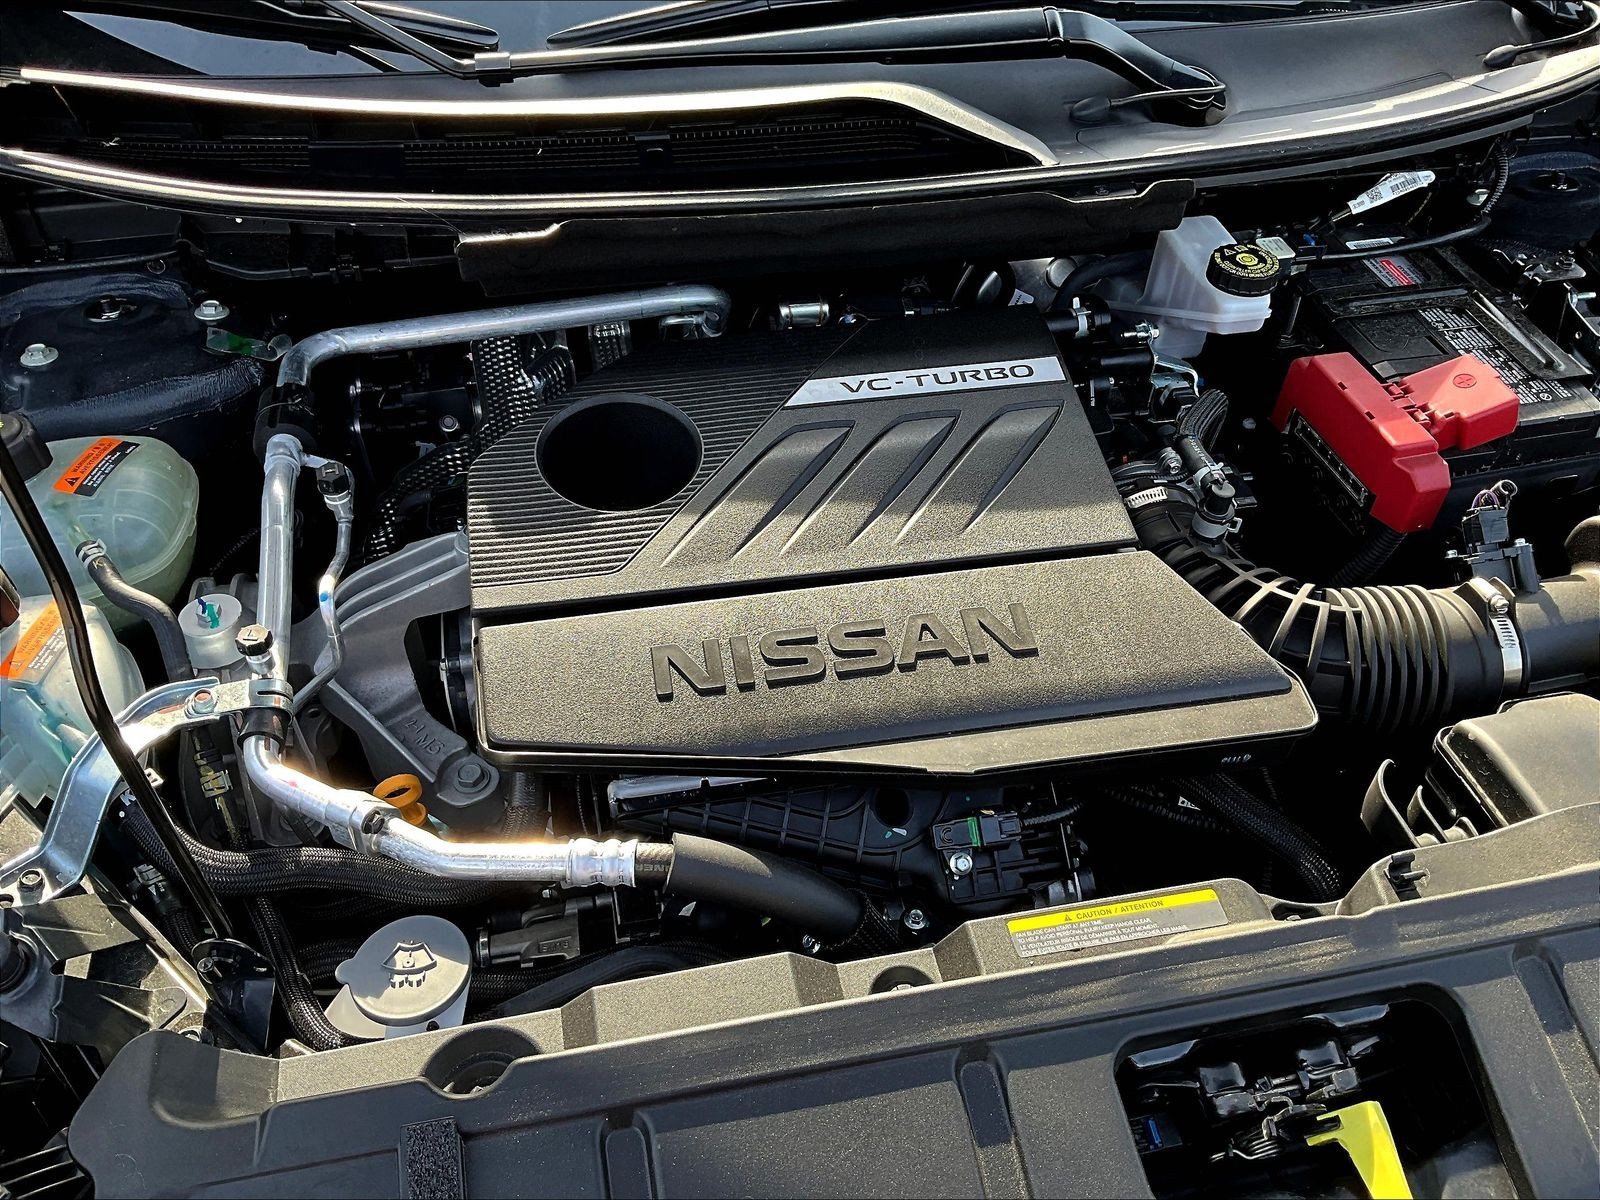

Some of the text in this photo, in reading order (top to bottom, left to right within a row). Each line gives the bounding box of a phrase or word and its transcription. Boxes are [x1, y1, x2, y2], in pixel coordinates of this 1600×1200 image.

[839, 364, 1035, 393] VC-TURBO
[650, 602, 1039, 700] NISSAN
[1076, 908, 1112, 919] CAUTION
[1120, 901, 1164, 914] ATTENTION
